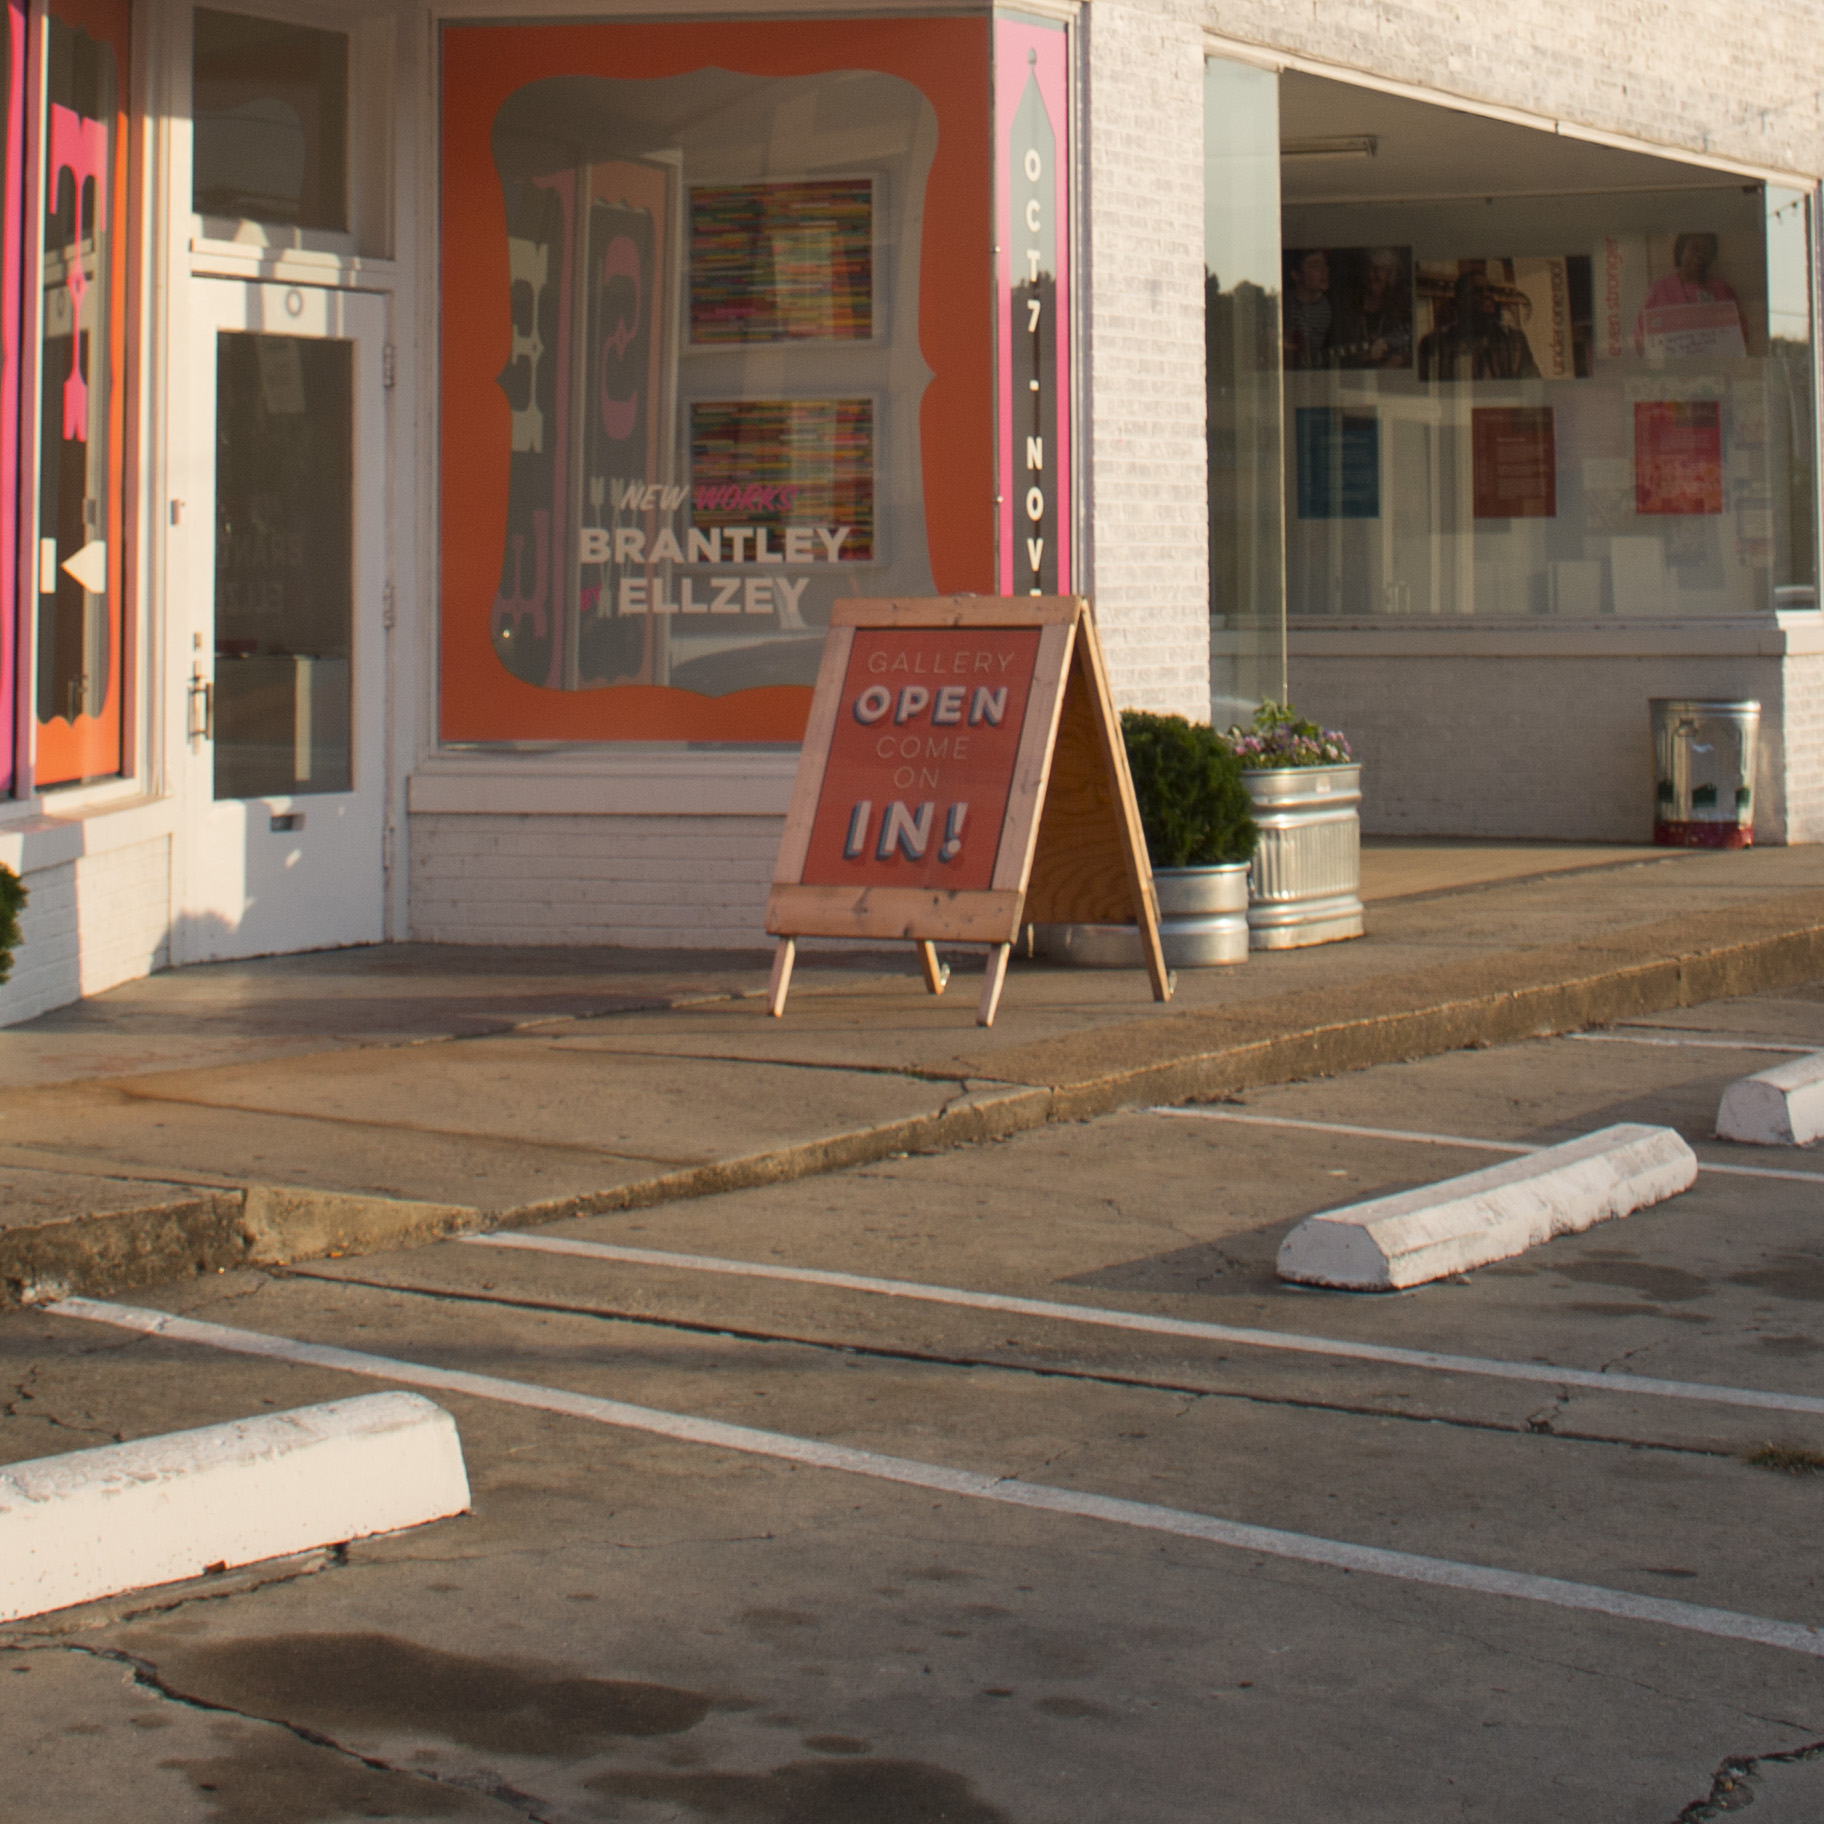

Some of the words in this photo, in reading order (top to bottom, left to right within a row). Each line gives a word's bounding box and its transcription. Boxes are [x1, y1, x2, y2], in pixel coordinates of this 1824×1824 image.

[620, 483, 689, 512] NEW
[695, 483, 798, 512] WORKS
[579, 526, 851, 565] BRANTLEY
[617, 576, 810, 616] ELLZEY
[867, 650, 1016, 675] GALLERY
[853, 684, 1009, 725] OPEN
[876, 735, 971, 761] COME
[893, 765, 940, 790] ON
[843, 800, 969, 863] IN!
